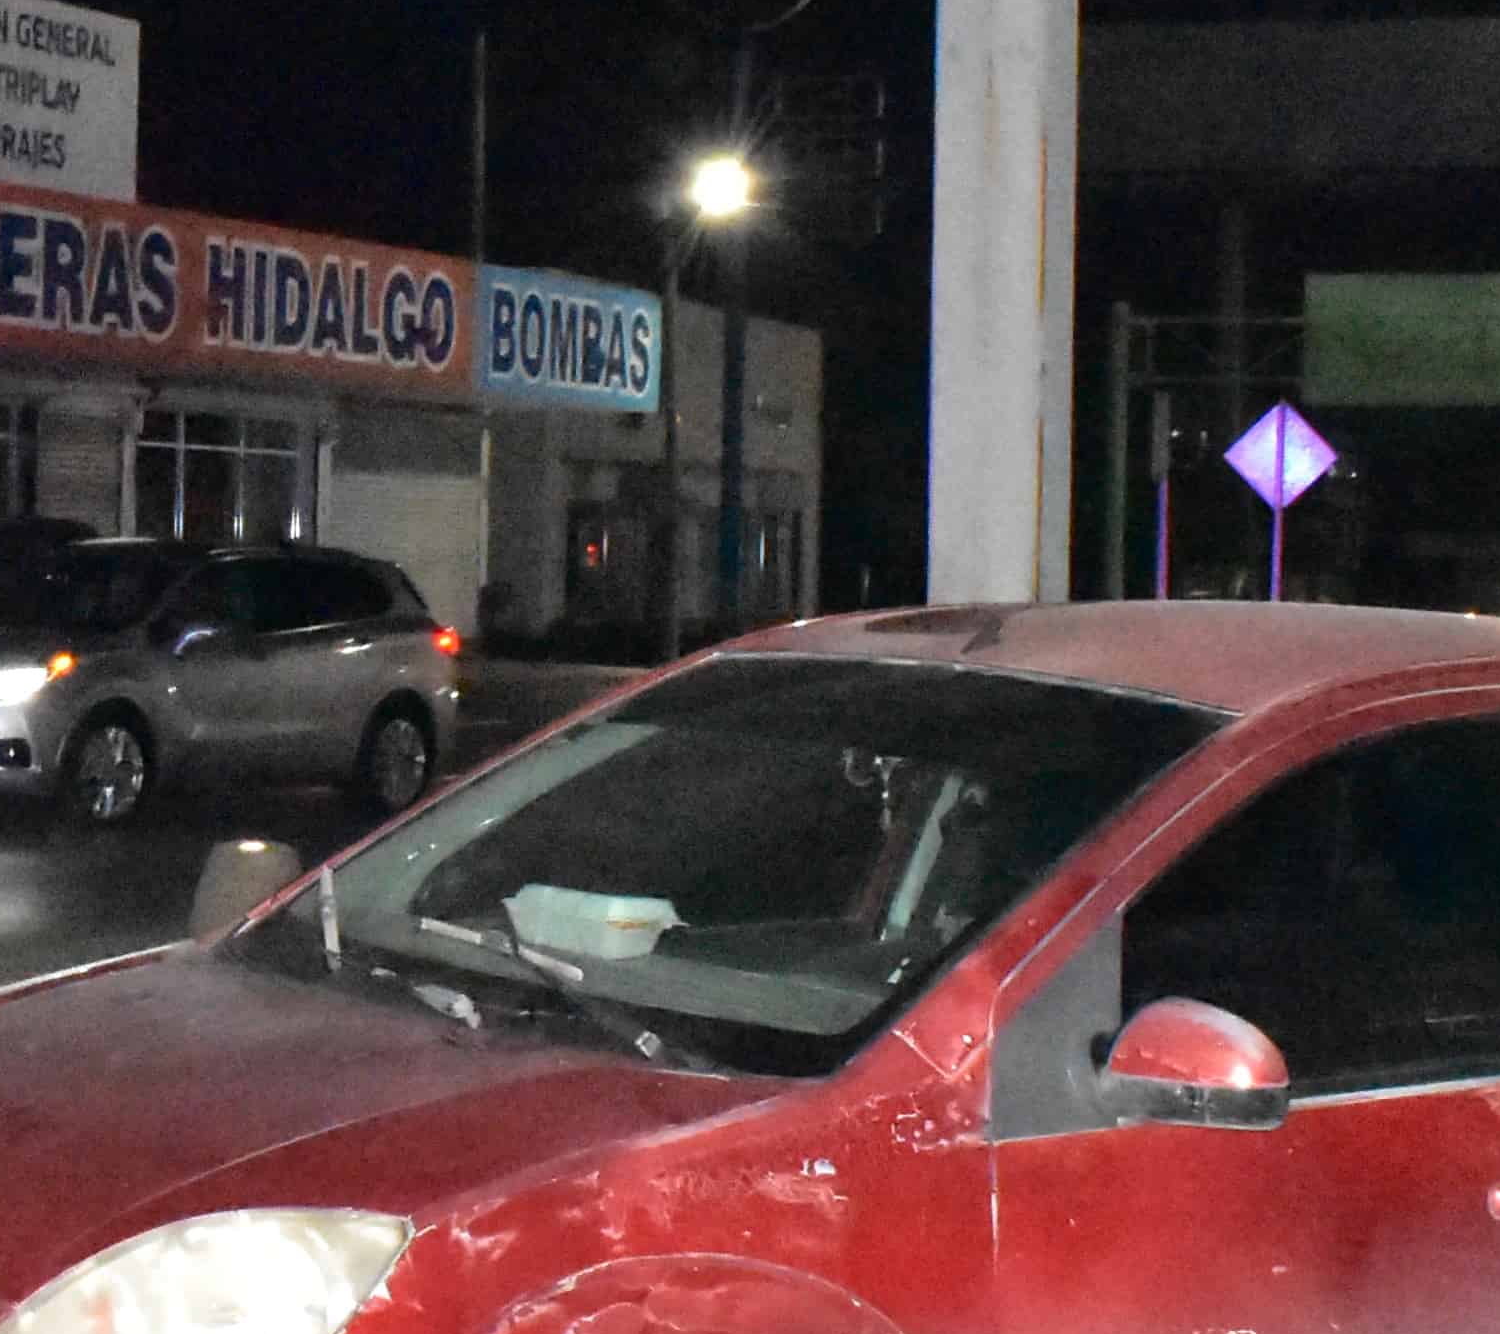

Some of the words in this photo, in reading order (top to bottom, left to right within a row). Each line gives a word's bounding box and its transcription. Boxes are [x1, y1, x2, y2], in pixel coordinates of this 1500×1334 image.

[16, 13, 116, 68] GENERAL
[205, 237, 456, 373] HIDALGO
[492, 282, 651, 396] BOMBAS
